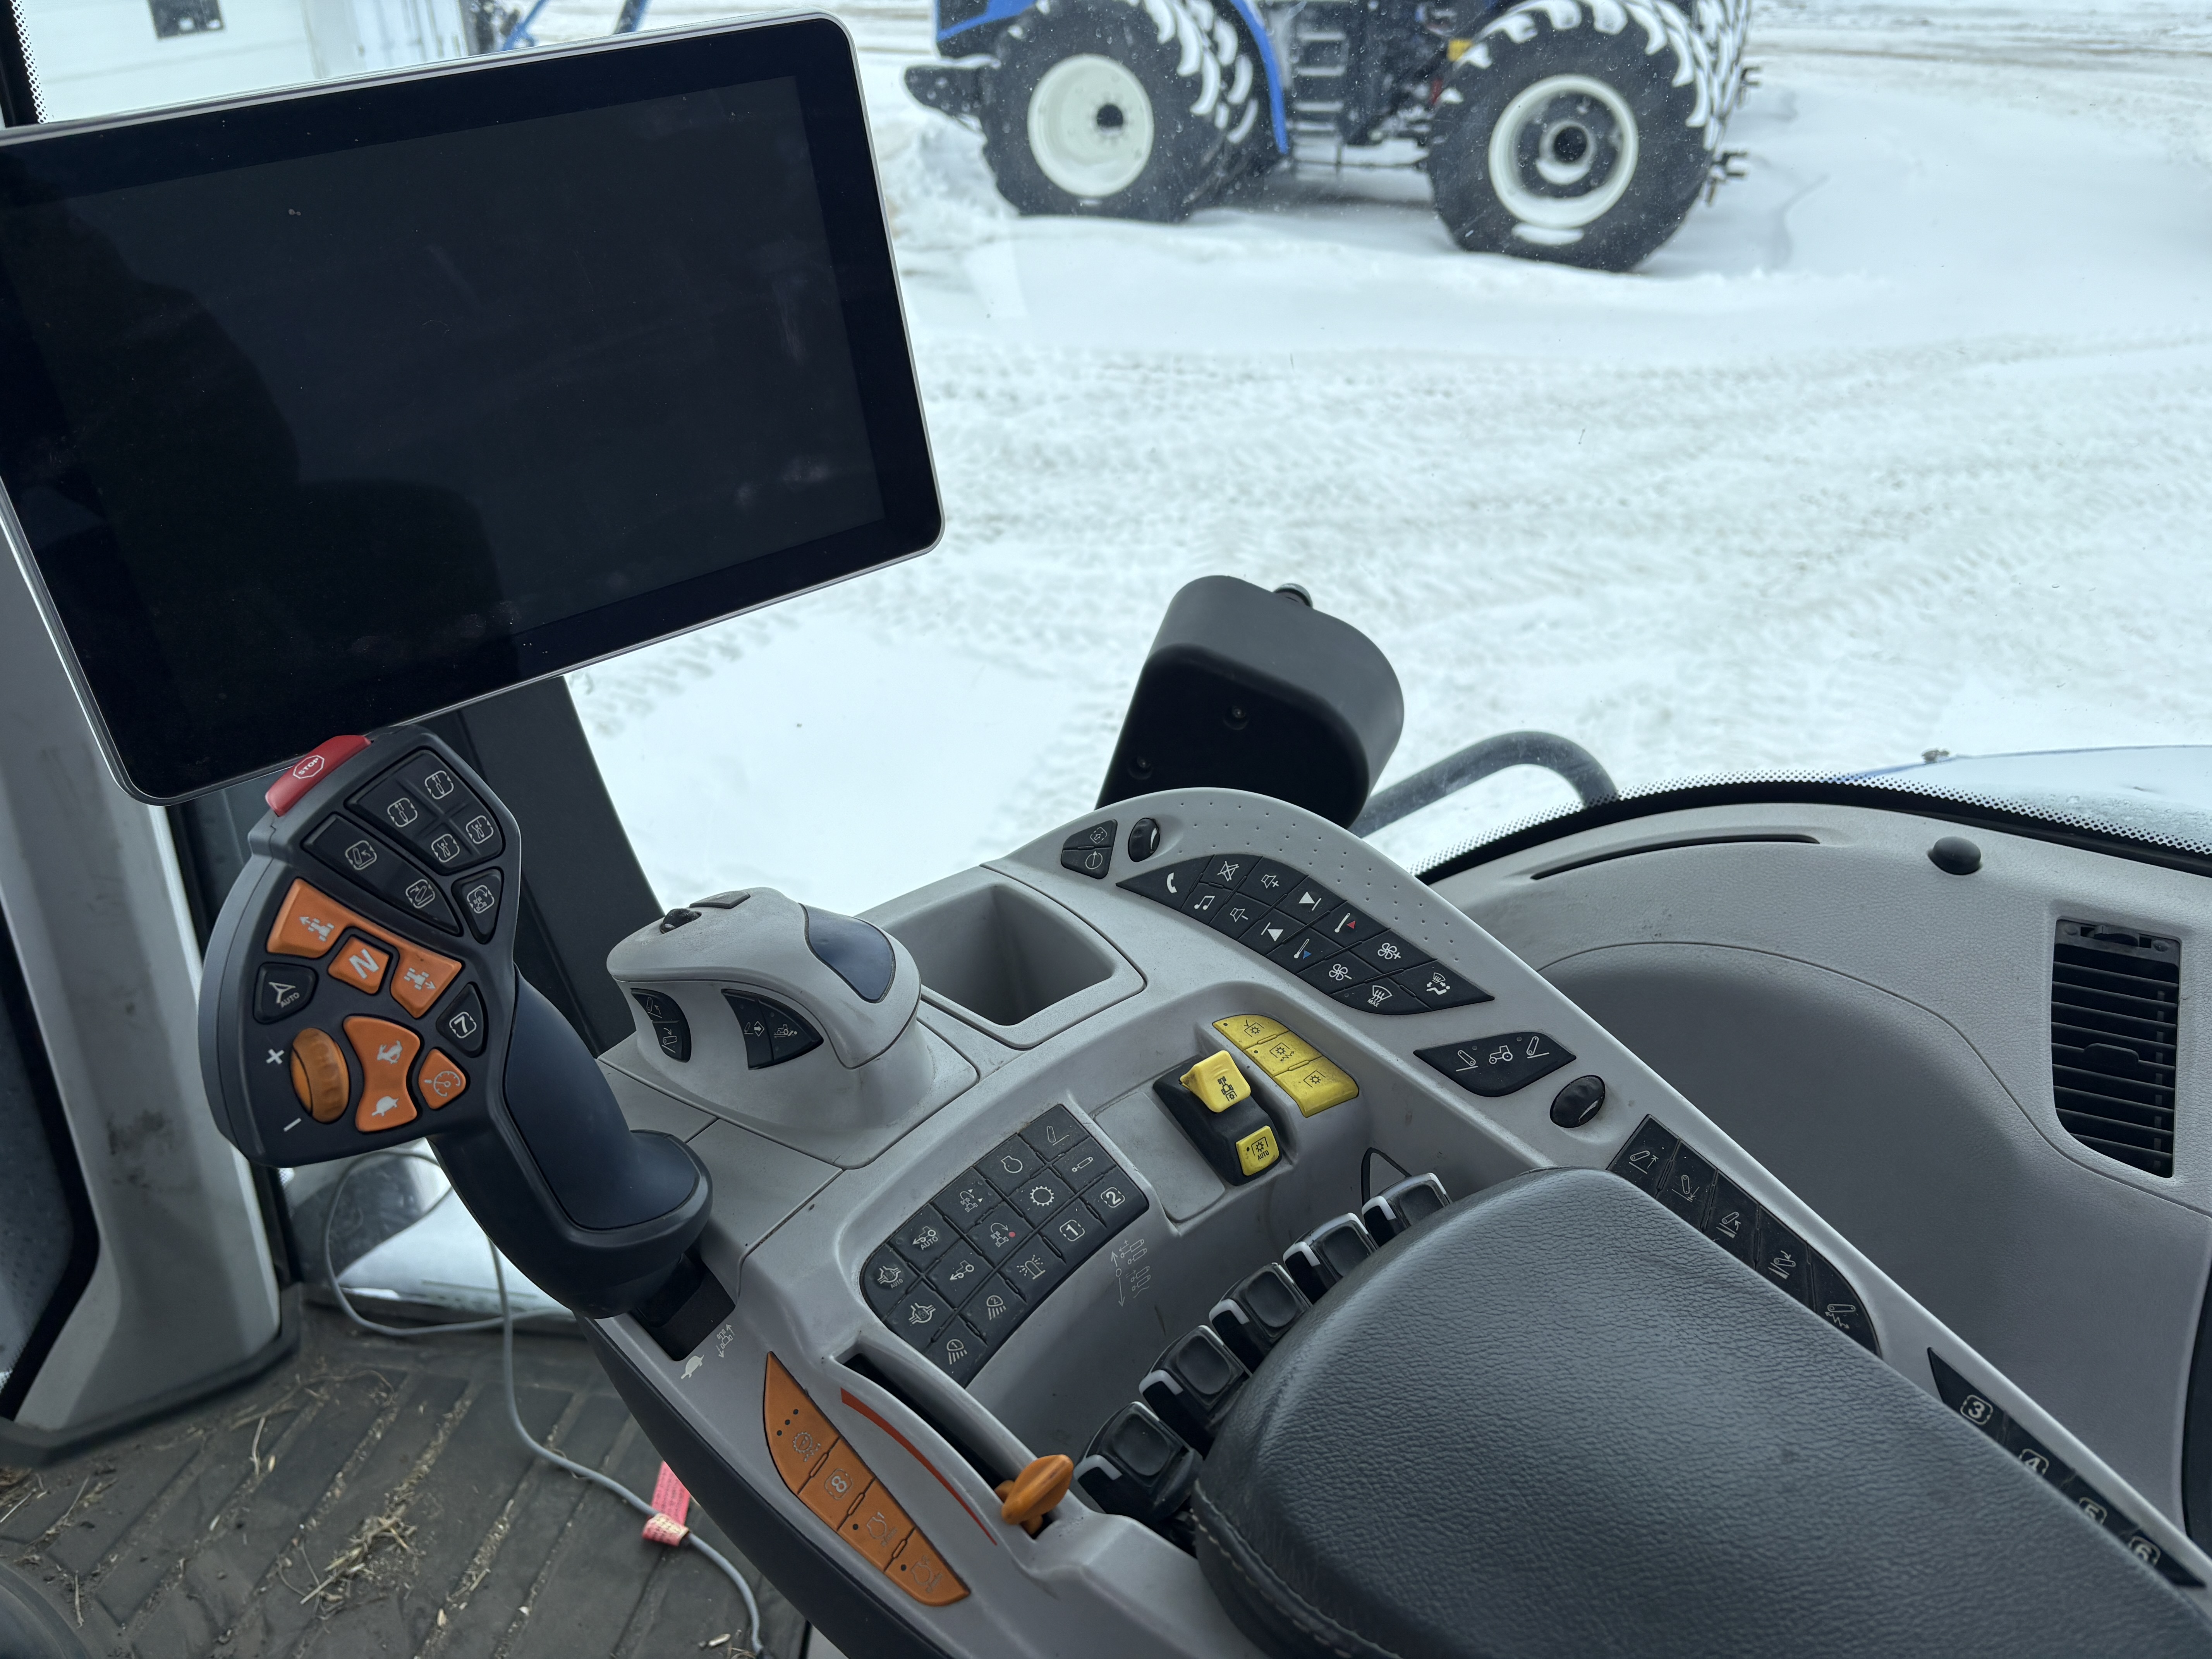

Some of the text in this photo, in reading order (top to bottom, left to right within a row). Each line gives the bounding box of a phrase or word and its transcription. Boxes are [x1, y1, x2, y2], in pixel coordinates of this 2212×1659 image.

[298, 758, 319, 775] STOP
[349, 948, 379, 979] N
[280, 992, 300, 1008] AUTO
[1367, 998, 1379, 1007] MAX
[454, 1015, 468, 1034] 7
[1257, 1150, 1269, 1161] AUTO
[1106, 1191, 1121, 1205] 2
[1066, 1224, 1079, 1236] 1
[921, 1237, 938, 1250] AUTO
[891, 1278, 903, 1289] AUTO
[1968, 1401, 1985, 1419] 3
[831, 1475, 847, 1492] 8
